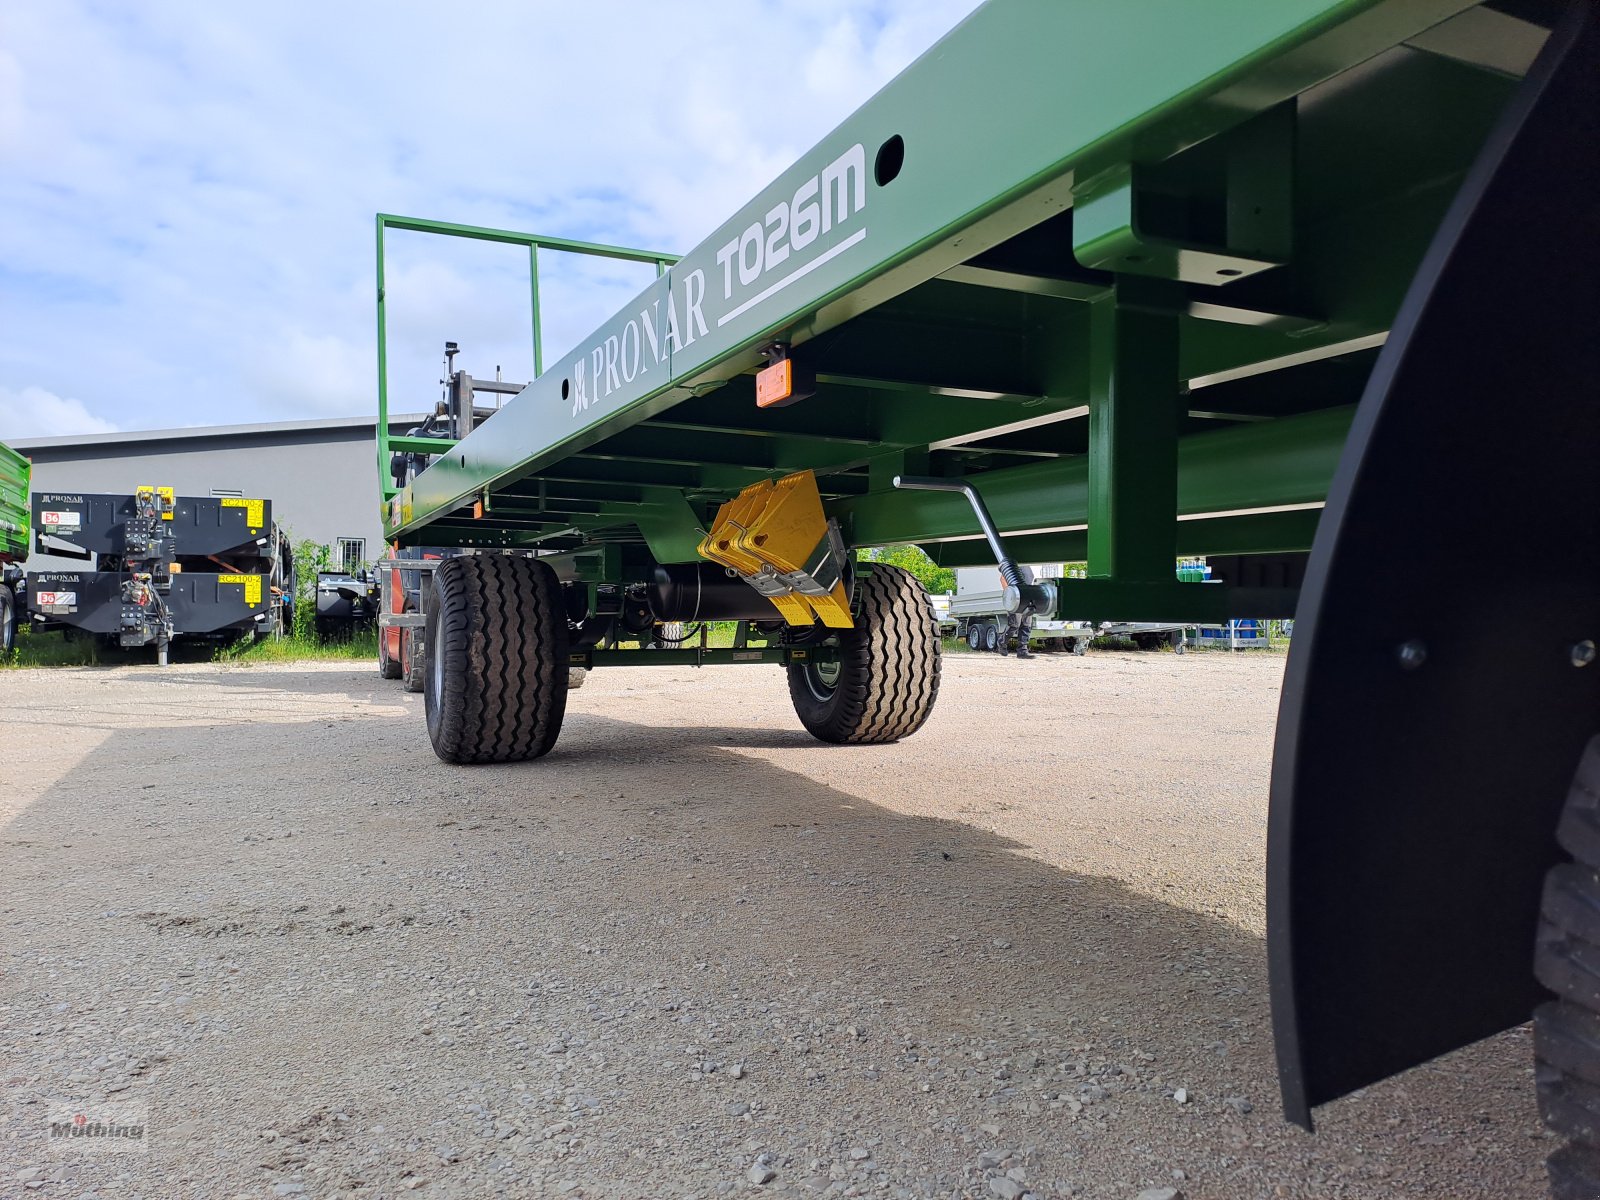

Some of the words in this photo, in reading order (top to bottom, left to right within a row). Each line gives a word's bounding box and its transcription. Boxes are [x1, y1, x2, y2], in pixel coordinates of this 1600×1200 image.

[591, 269, 710, 405] PRONAR
[50, 495, 83, 503] PRONAR
[221, 499, 263, 508] RC2100-2
[46, 513, 59, 523] 36
[219, 575, 261, 583] RC2100-2
[41, 594, 55, 603] 36
